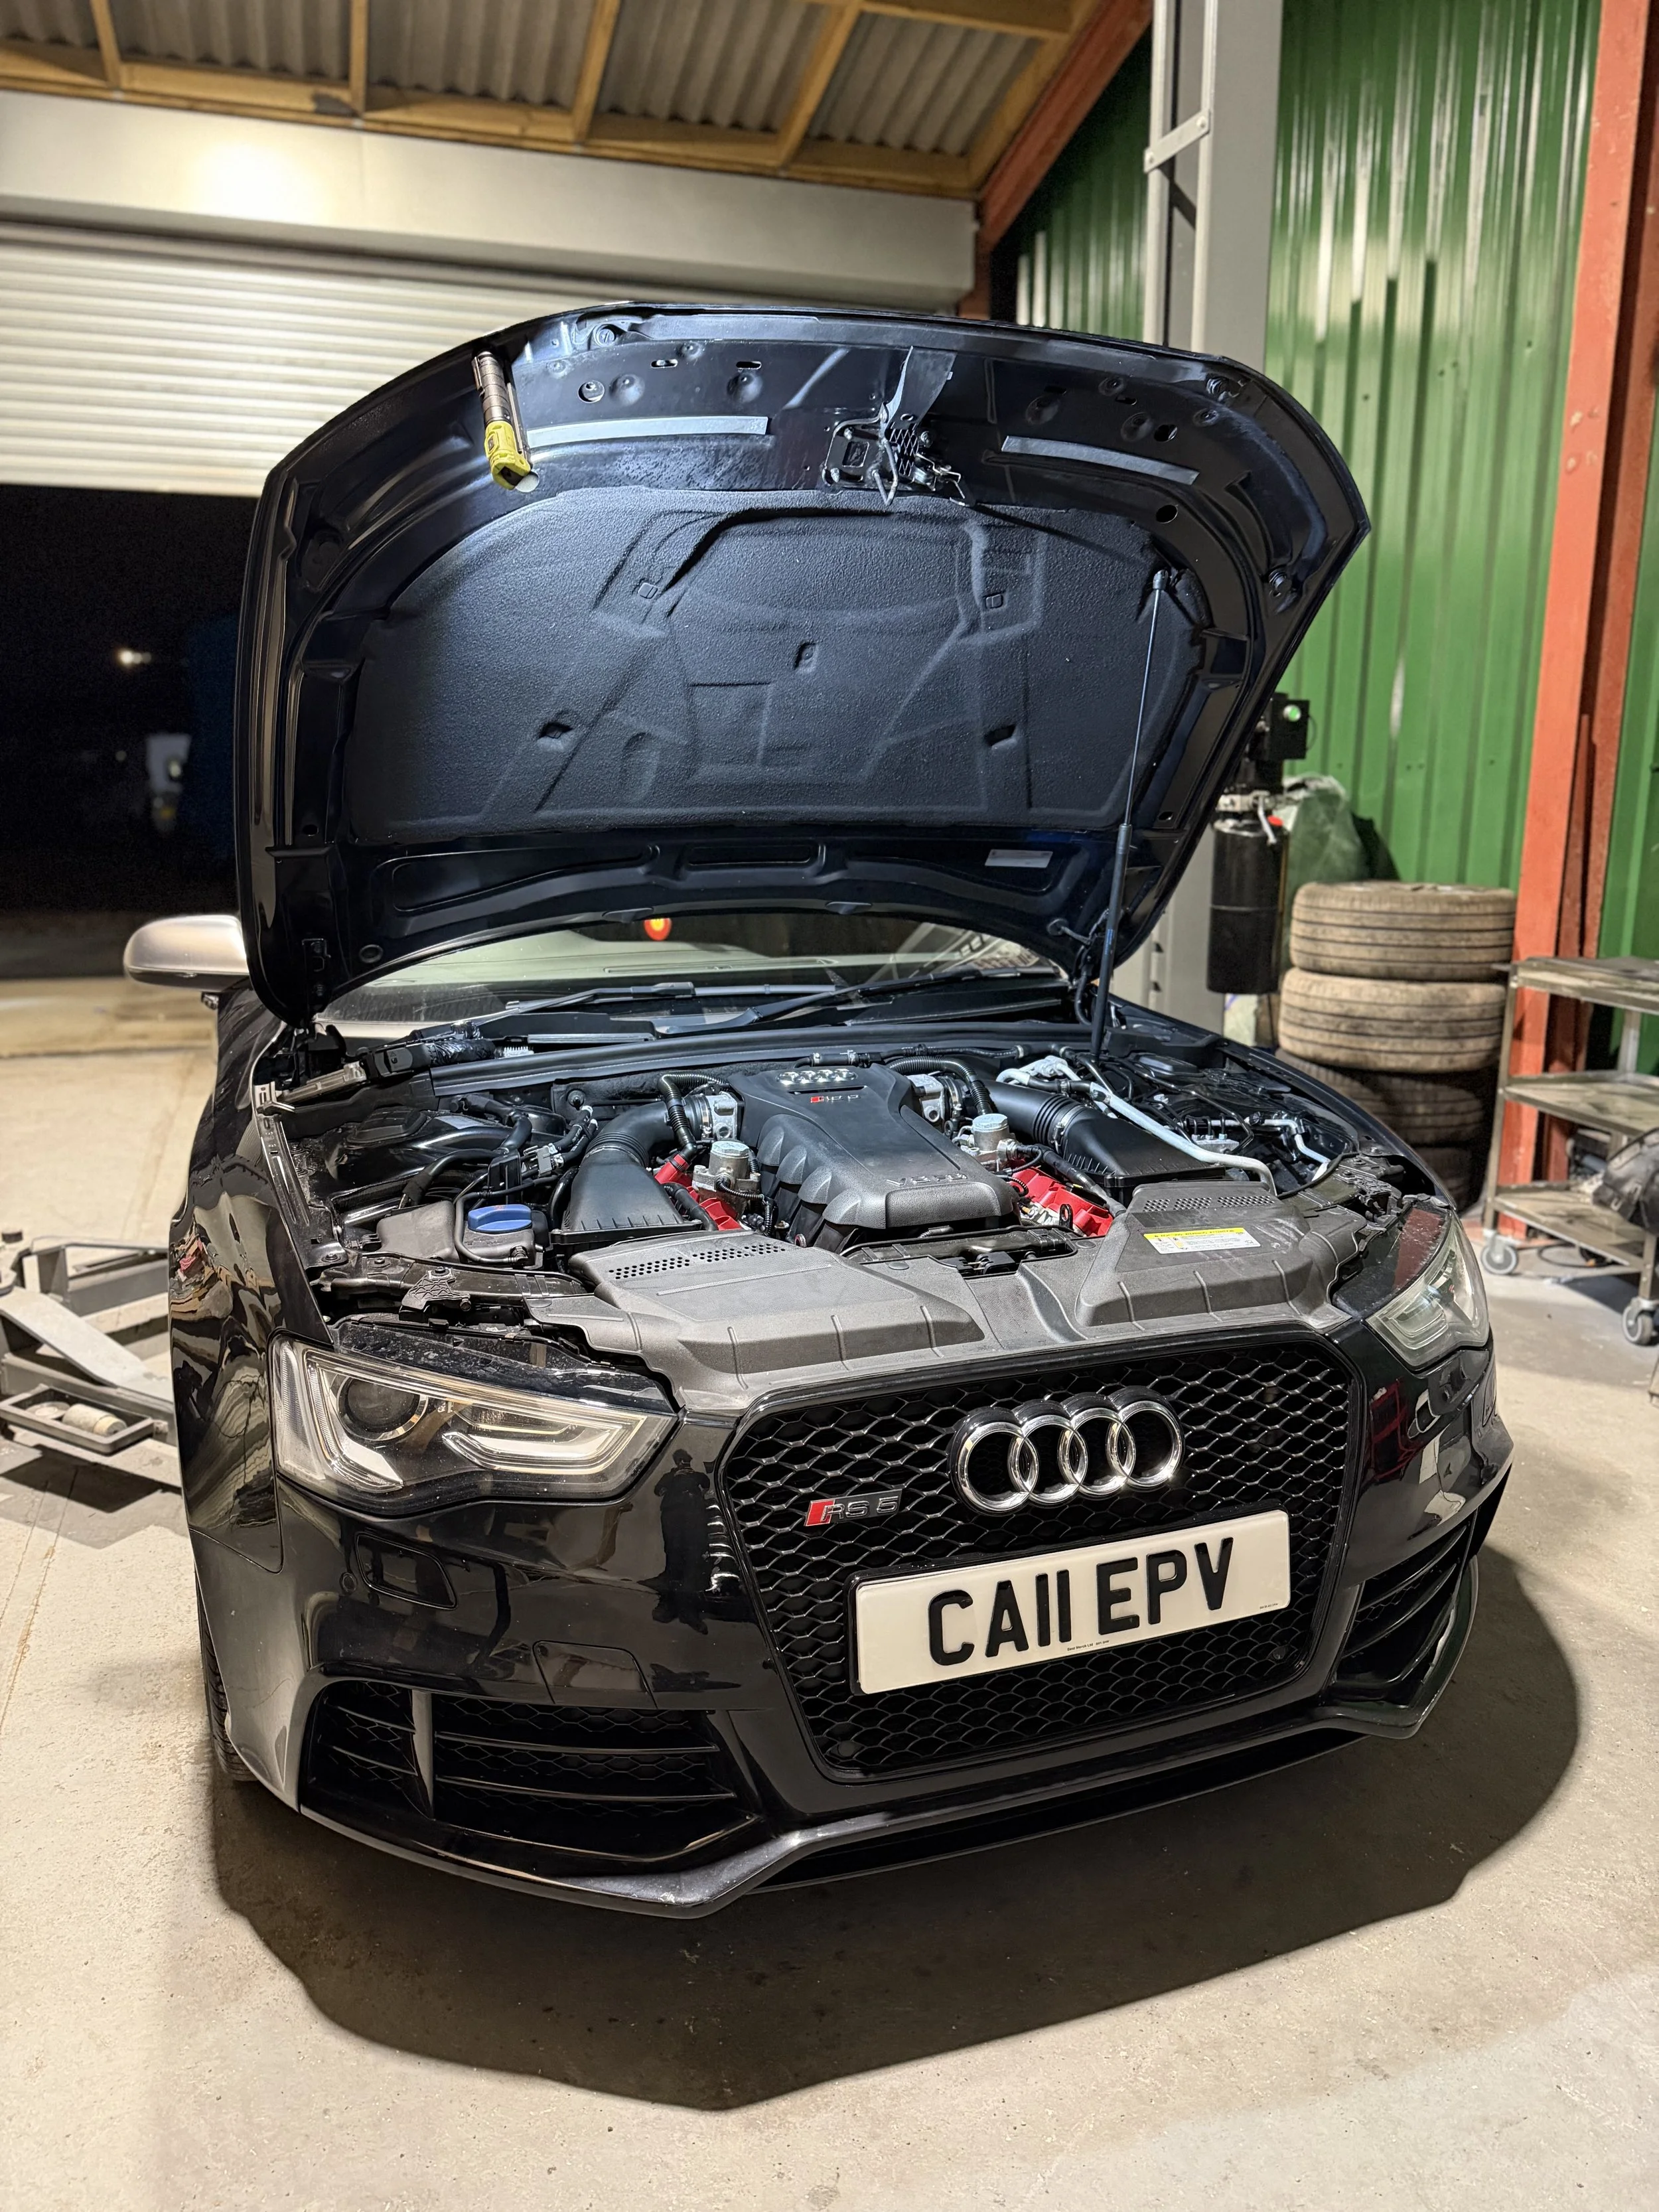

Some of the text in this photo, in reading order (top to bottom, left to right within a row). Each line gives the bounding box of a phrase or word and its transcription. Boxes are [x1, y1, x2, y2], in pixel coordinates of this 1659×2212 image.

[820, 1496, 899, 1522] RS 5
[1096, 1536, 1234, 1636] EPV
